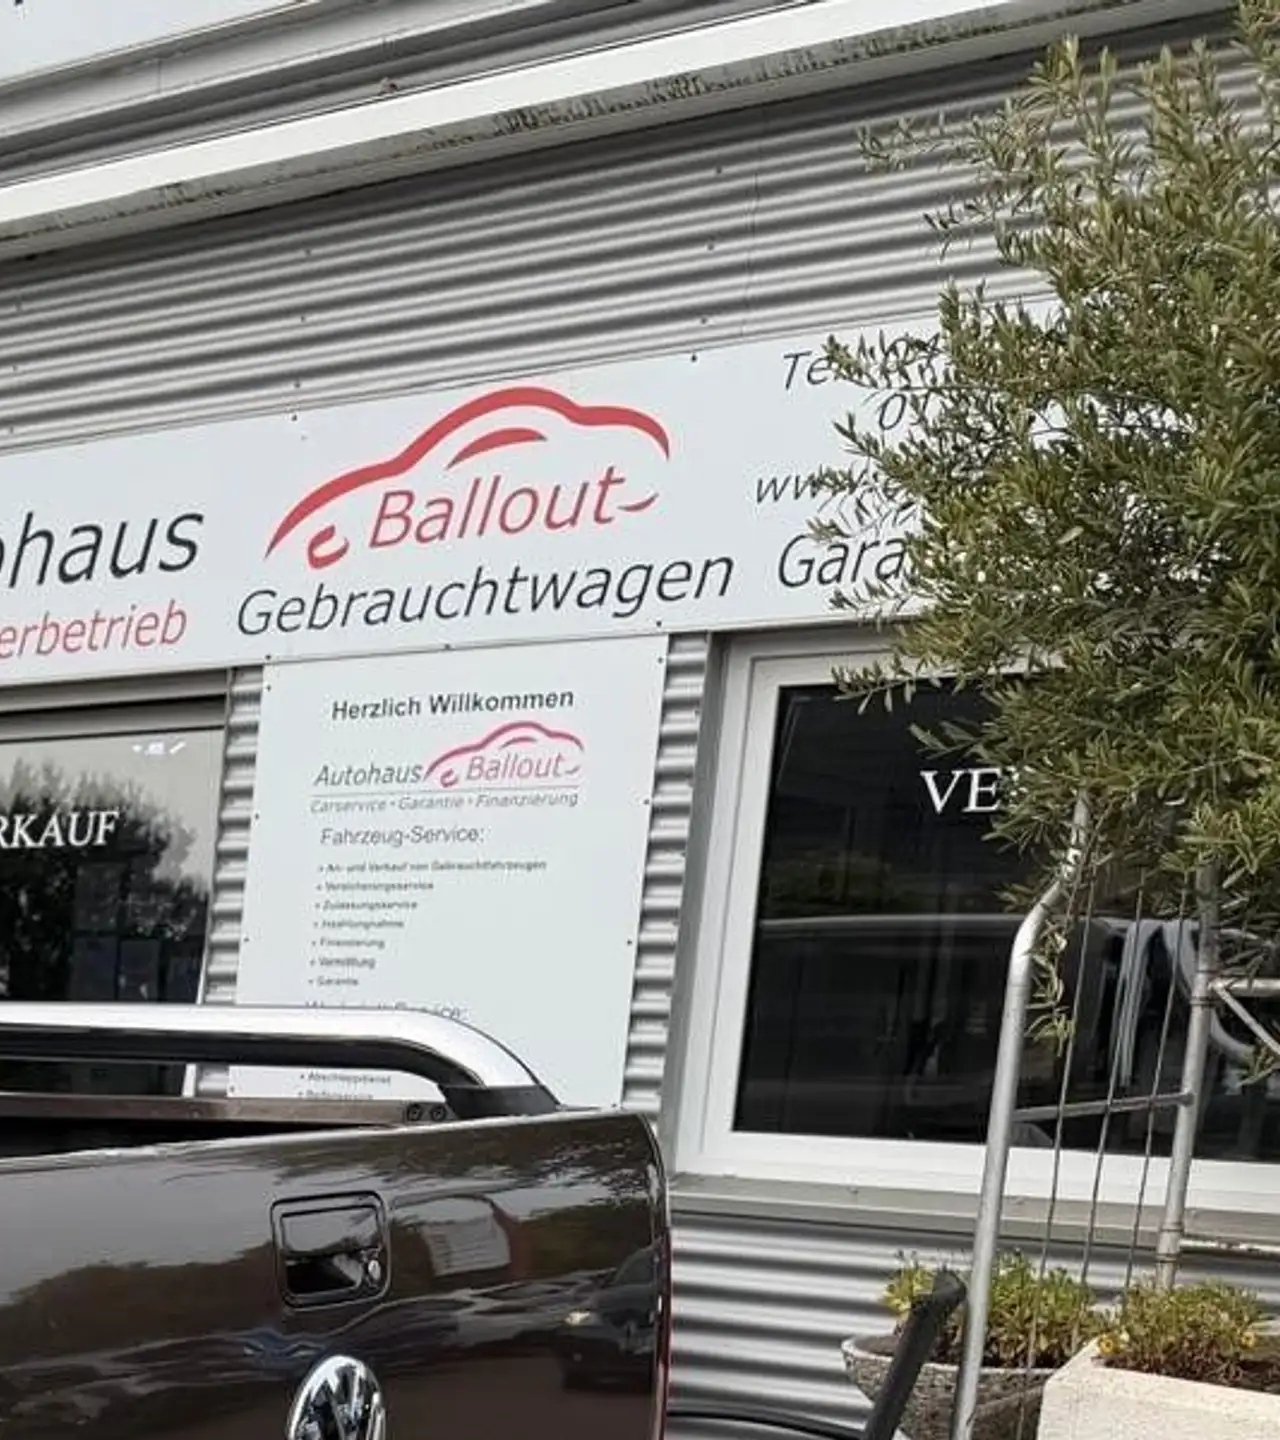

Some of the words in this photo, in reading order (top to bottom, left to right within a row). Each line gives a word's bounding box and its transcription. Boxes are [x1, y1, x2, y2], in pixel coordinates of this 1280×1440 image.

[368, 465, 626, 550] Ballout
[236, 555, 735, 637] Gebrauchtwagen
[778, 534, 908, 588] Gara
[331, 697, 422, 721] Herzlich
[428, 690, 574, 714] Willkommen
[314, 763, 424, 787] Autohaus
[466, 750, 566, 781] Ballout
[310, 800, 386, 813] Carservice
[398, 797, 464, 811] Garantie
[475, 793, 579, 808] Finanzierung
[920, 768, 1002, 815] VE
[320, 824, 486, 848] Fahrzeug-Service:
